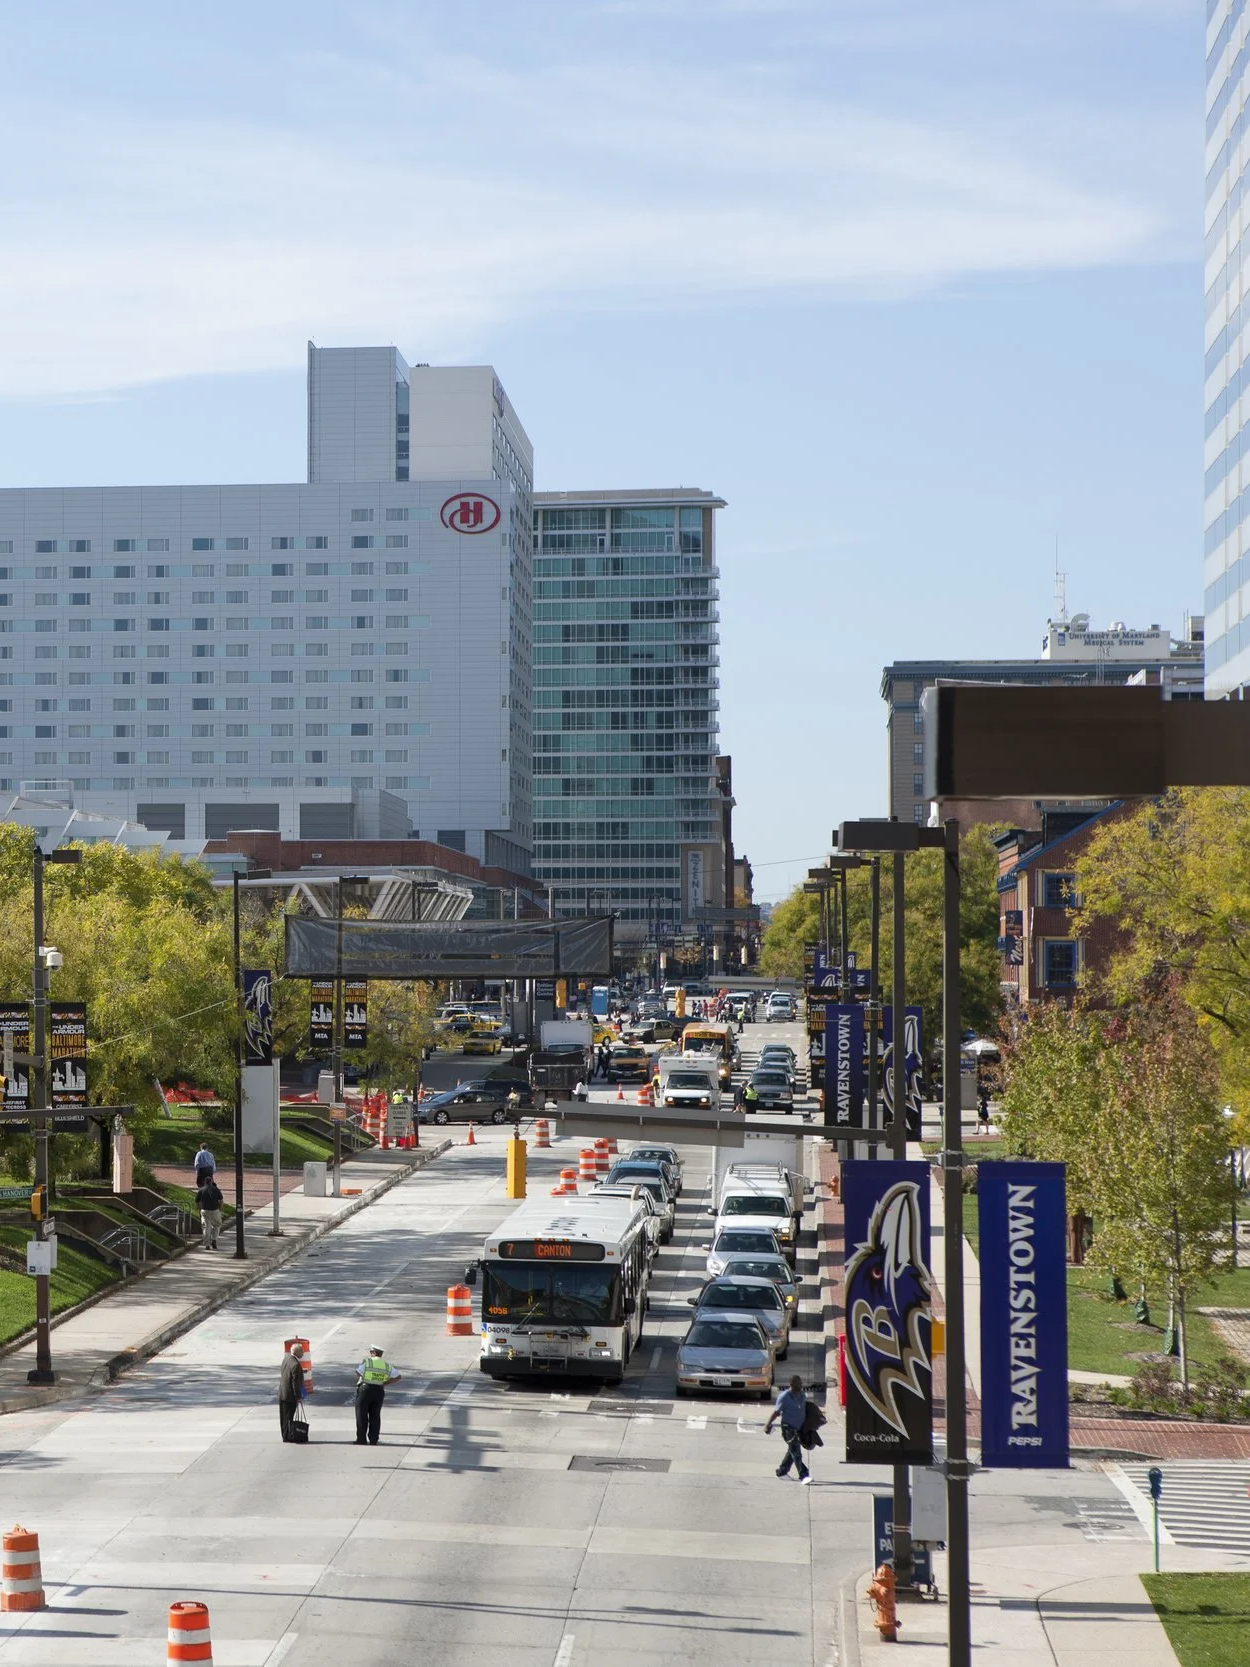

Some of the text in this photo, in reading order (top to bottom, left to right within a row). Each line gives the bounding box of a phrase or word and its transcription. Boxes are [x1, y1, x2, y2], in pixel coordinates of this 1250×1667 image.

[1069, 632, 1109, 640] UNIVERSITY
[1123, 631, 1160, 639] MARYLAND
[52, 1035, 85, 1047] BALTIMORE
[52, 1047, 85, 1059] MARATHON
[837, 1013, 852, 1123] RAVENSTOWN
[4, 1189, 29, 1198] HANOVER
[506, 1243, 572, 1257] 7 CANTON
[1007, 1181, 1043, 1431] RAVENSTOWN
[487, 1325, 510, 1334] 04098
[853, 1433, 900, 1443] Coca-Cola
[1007, 1436, 1043, 1447] PEPSI
